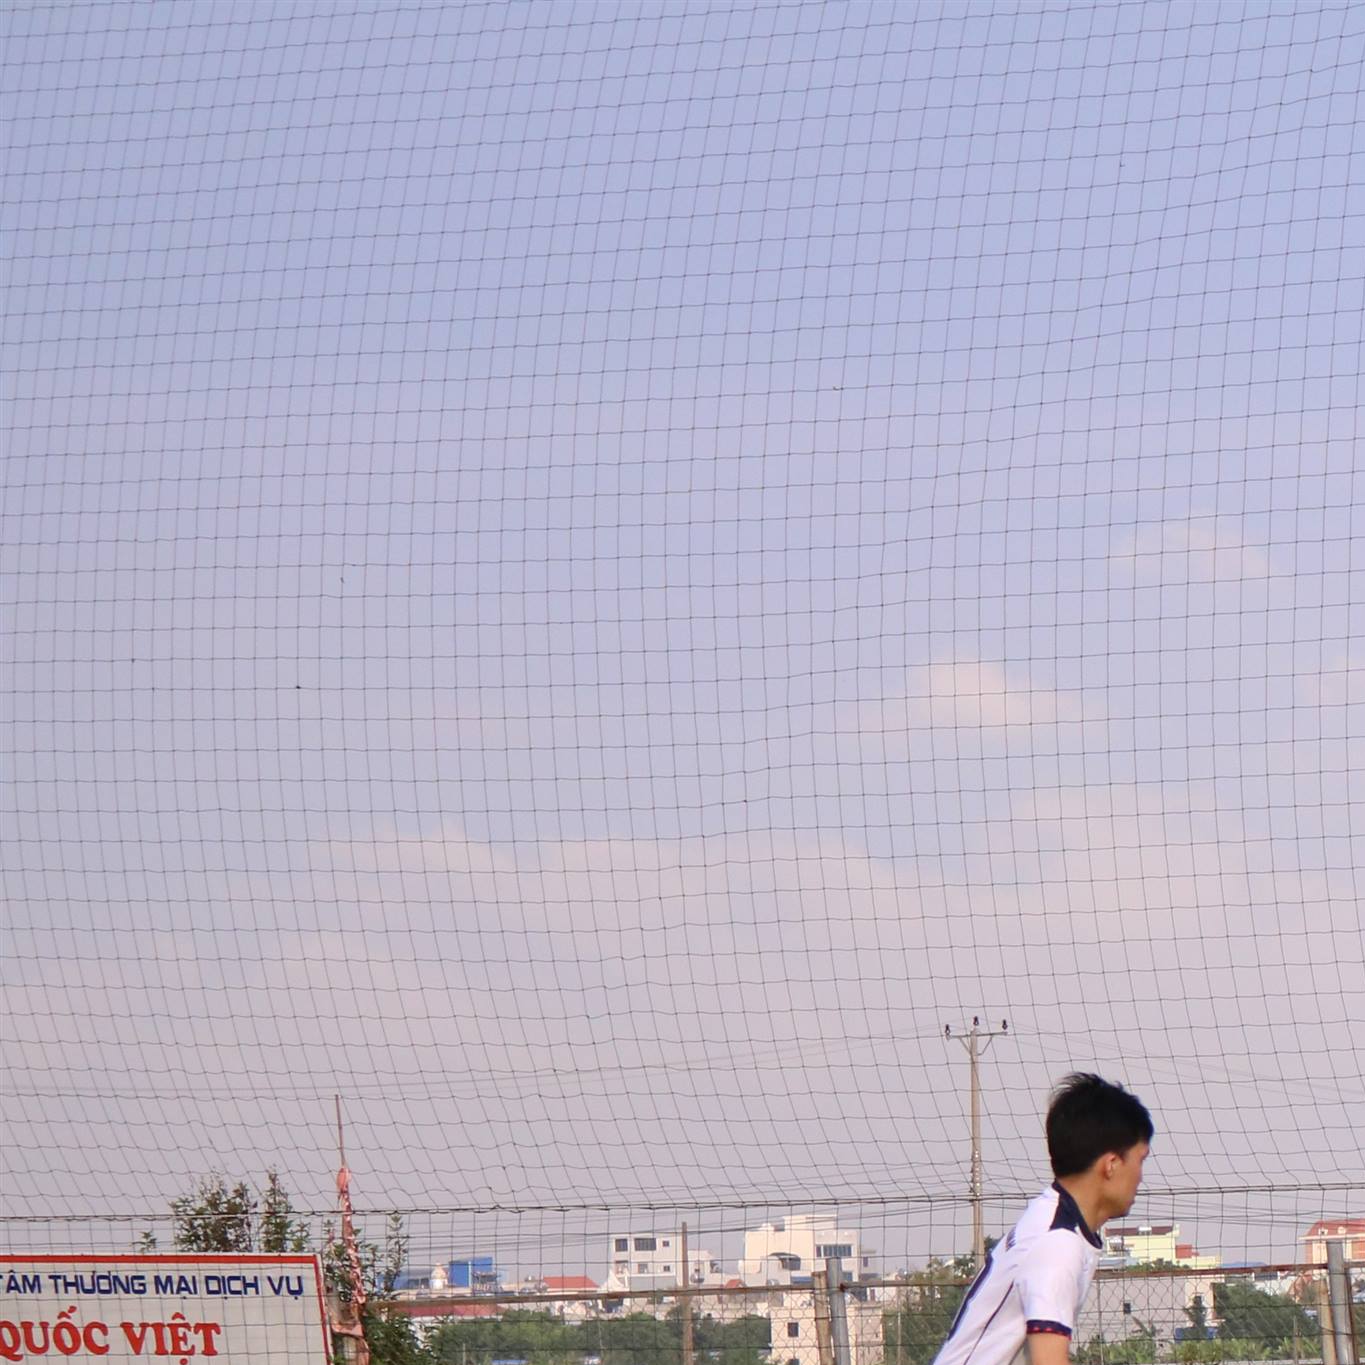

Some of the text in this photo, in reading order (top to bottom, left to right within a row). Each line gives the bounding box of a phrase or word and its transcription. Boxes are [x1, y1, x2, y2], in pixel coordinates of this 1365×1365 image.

[0, 1270, 304, 1300] ÂM THƯƠNG MẠI DỊCH VỤ
[0, 1305, 222, 1365] QUỐC VIỆT
